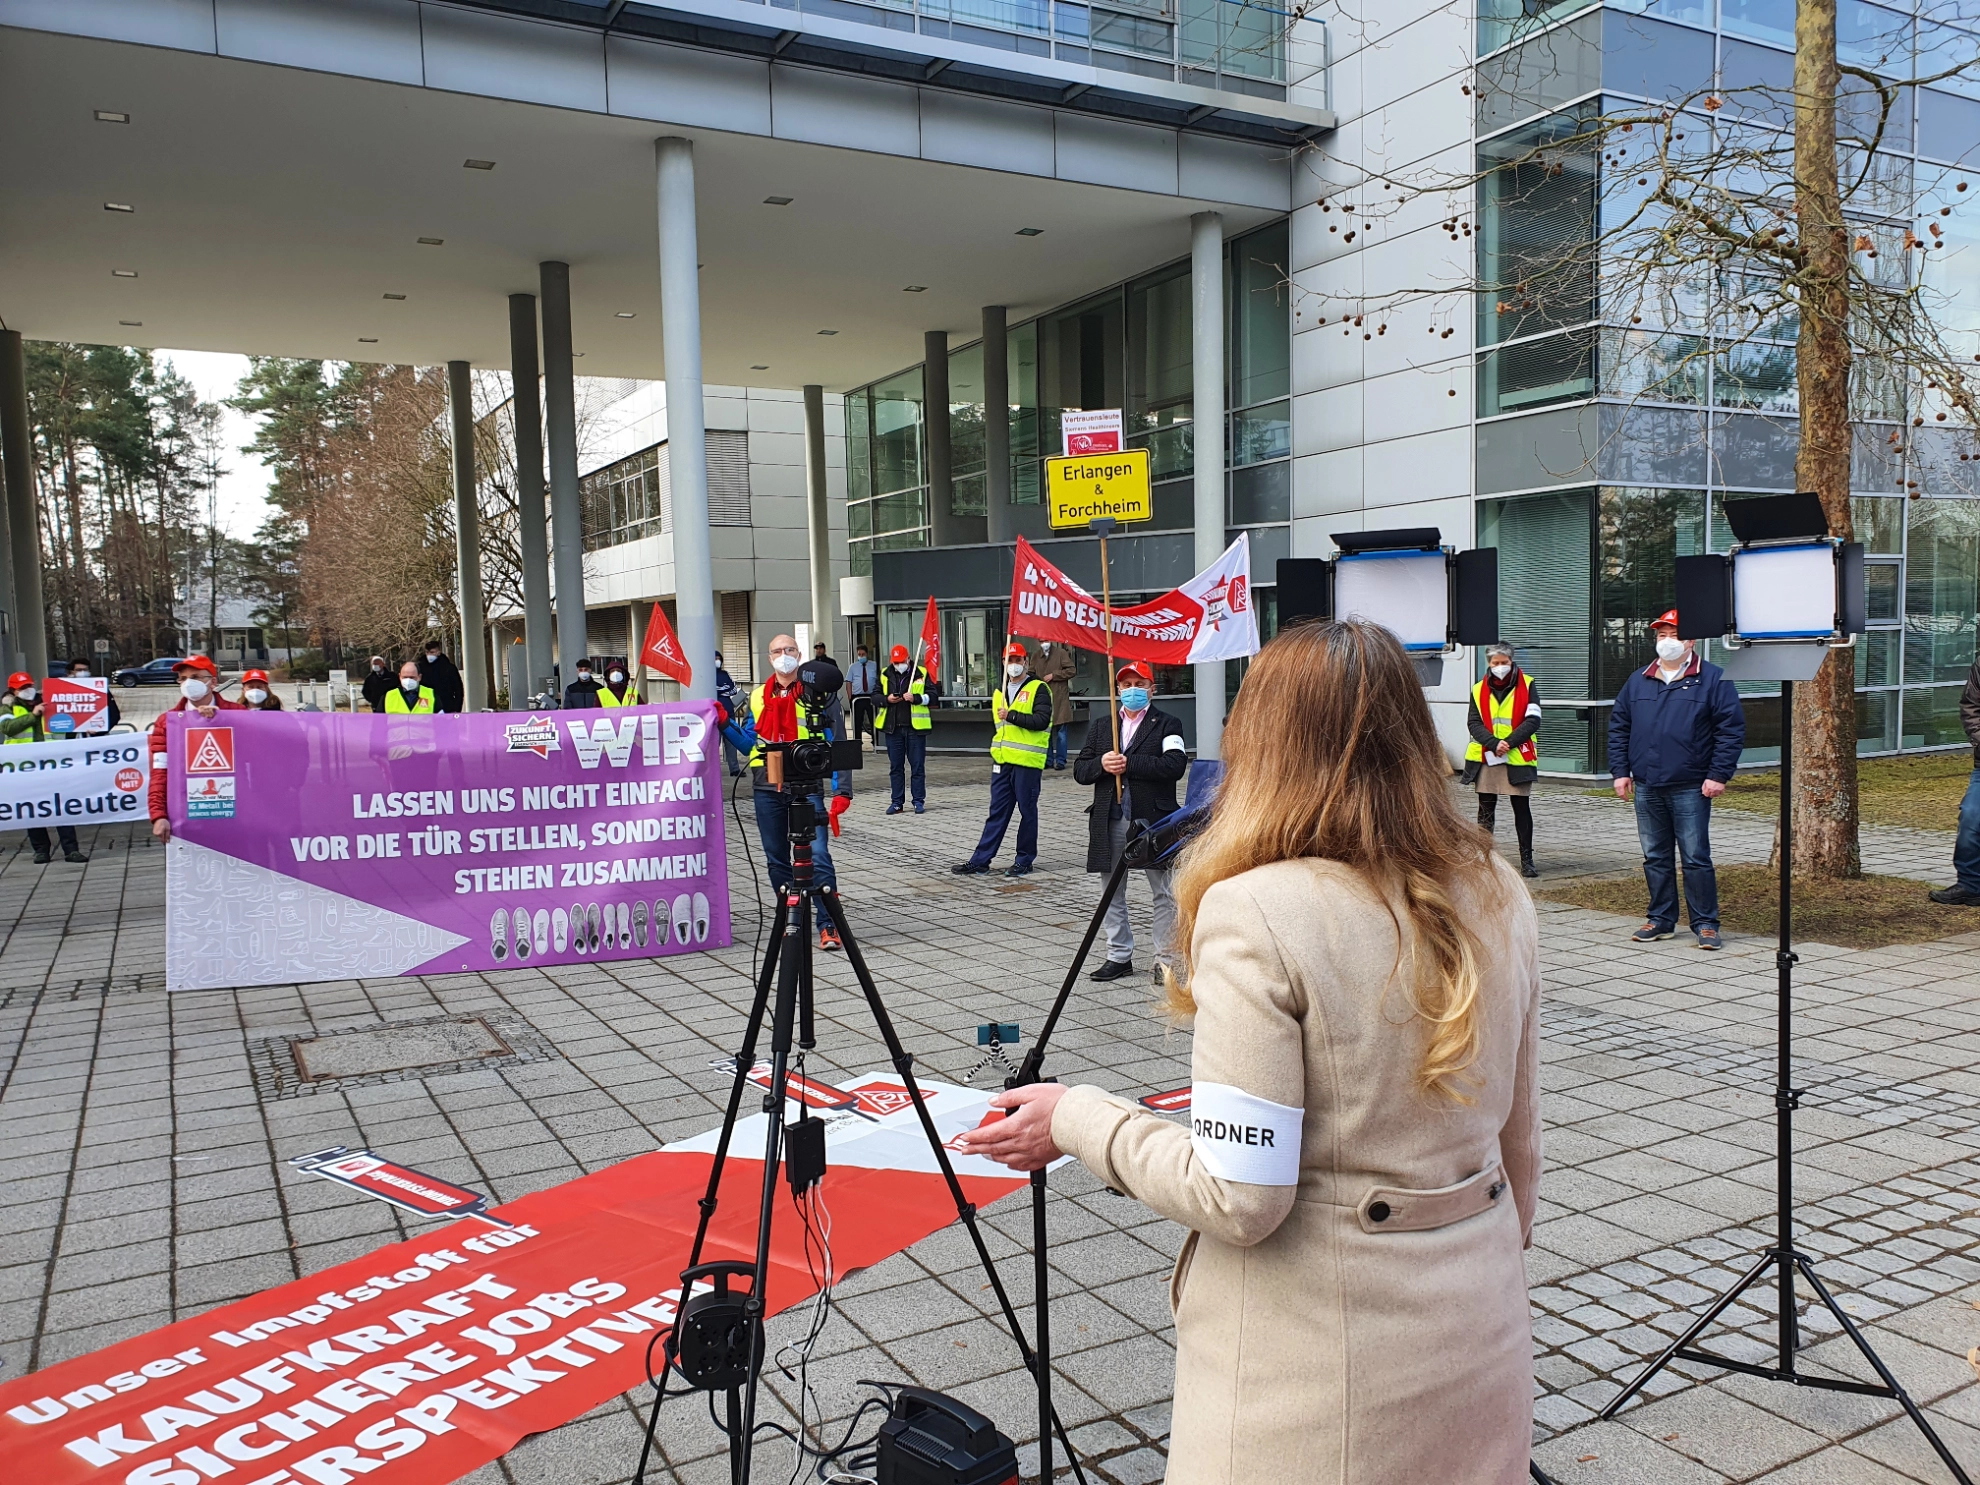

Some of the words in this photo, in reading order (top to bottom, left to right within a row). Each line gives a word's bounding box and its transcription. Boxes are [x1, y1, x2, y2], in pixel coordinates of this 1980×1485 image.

[1064, 413, 1120, 424] Vertrauensleute
[1063, 464, 1132, 481] Erlangen
[1094, 483, 1104, 495] &
[1058, 498, 1141, 519] Forchheim
[1018, 591, 1062, 620] UND
[51, 693, 101, 703] ARBEITS-
[56, 702, 97, 713] PLÄTZE
[510, 725, 550, 734] ZUKUNFT
[512, 732, 555, 742] SICHERN.
[565, 713, 707, 769] WIR
[0, 792, 138, 821] ensleute
[222, 801, 234, 809] bei
[353, 790, 454, 819] LASSEN
[461, 787, 516, 815] UNS
[522, 783, 600, 811] NICHT
[605, 776, 705, 807] EINFACH
[290, 835, 351, 862] VOR
[357, 833, 402, 860] DIE
[407, 824, 463, 857] TÜR
[469, 823, 587, 851] STELLEN,
[591, 815, 706, 846] SONDERN
[454, 864, 553, 894] STEHEN
[560, 852, 708, 888] ZUSAMMEN!
[1194, 1118, 1275, 1148] ORDNER
[5, 1346, 208, 1425] Unser
[209, 1248, 469, 1348] Impfstoff
[461, 1224, 541, 1255] für
[63, 1273, 518, 1468] KAUFKRAFT
[124, 1341, 479, 1485] SICHERE
[458, 1277, 628, 1356] JOBS
